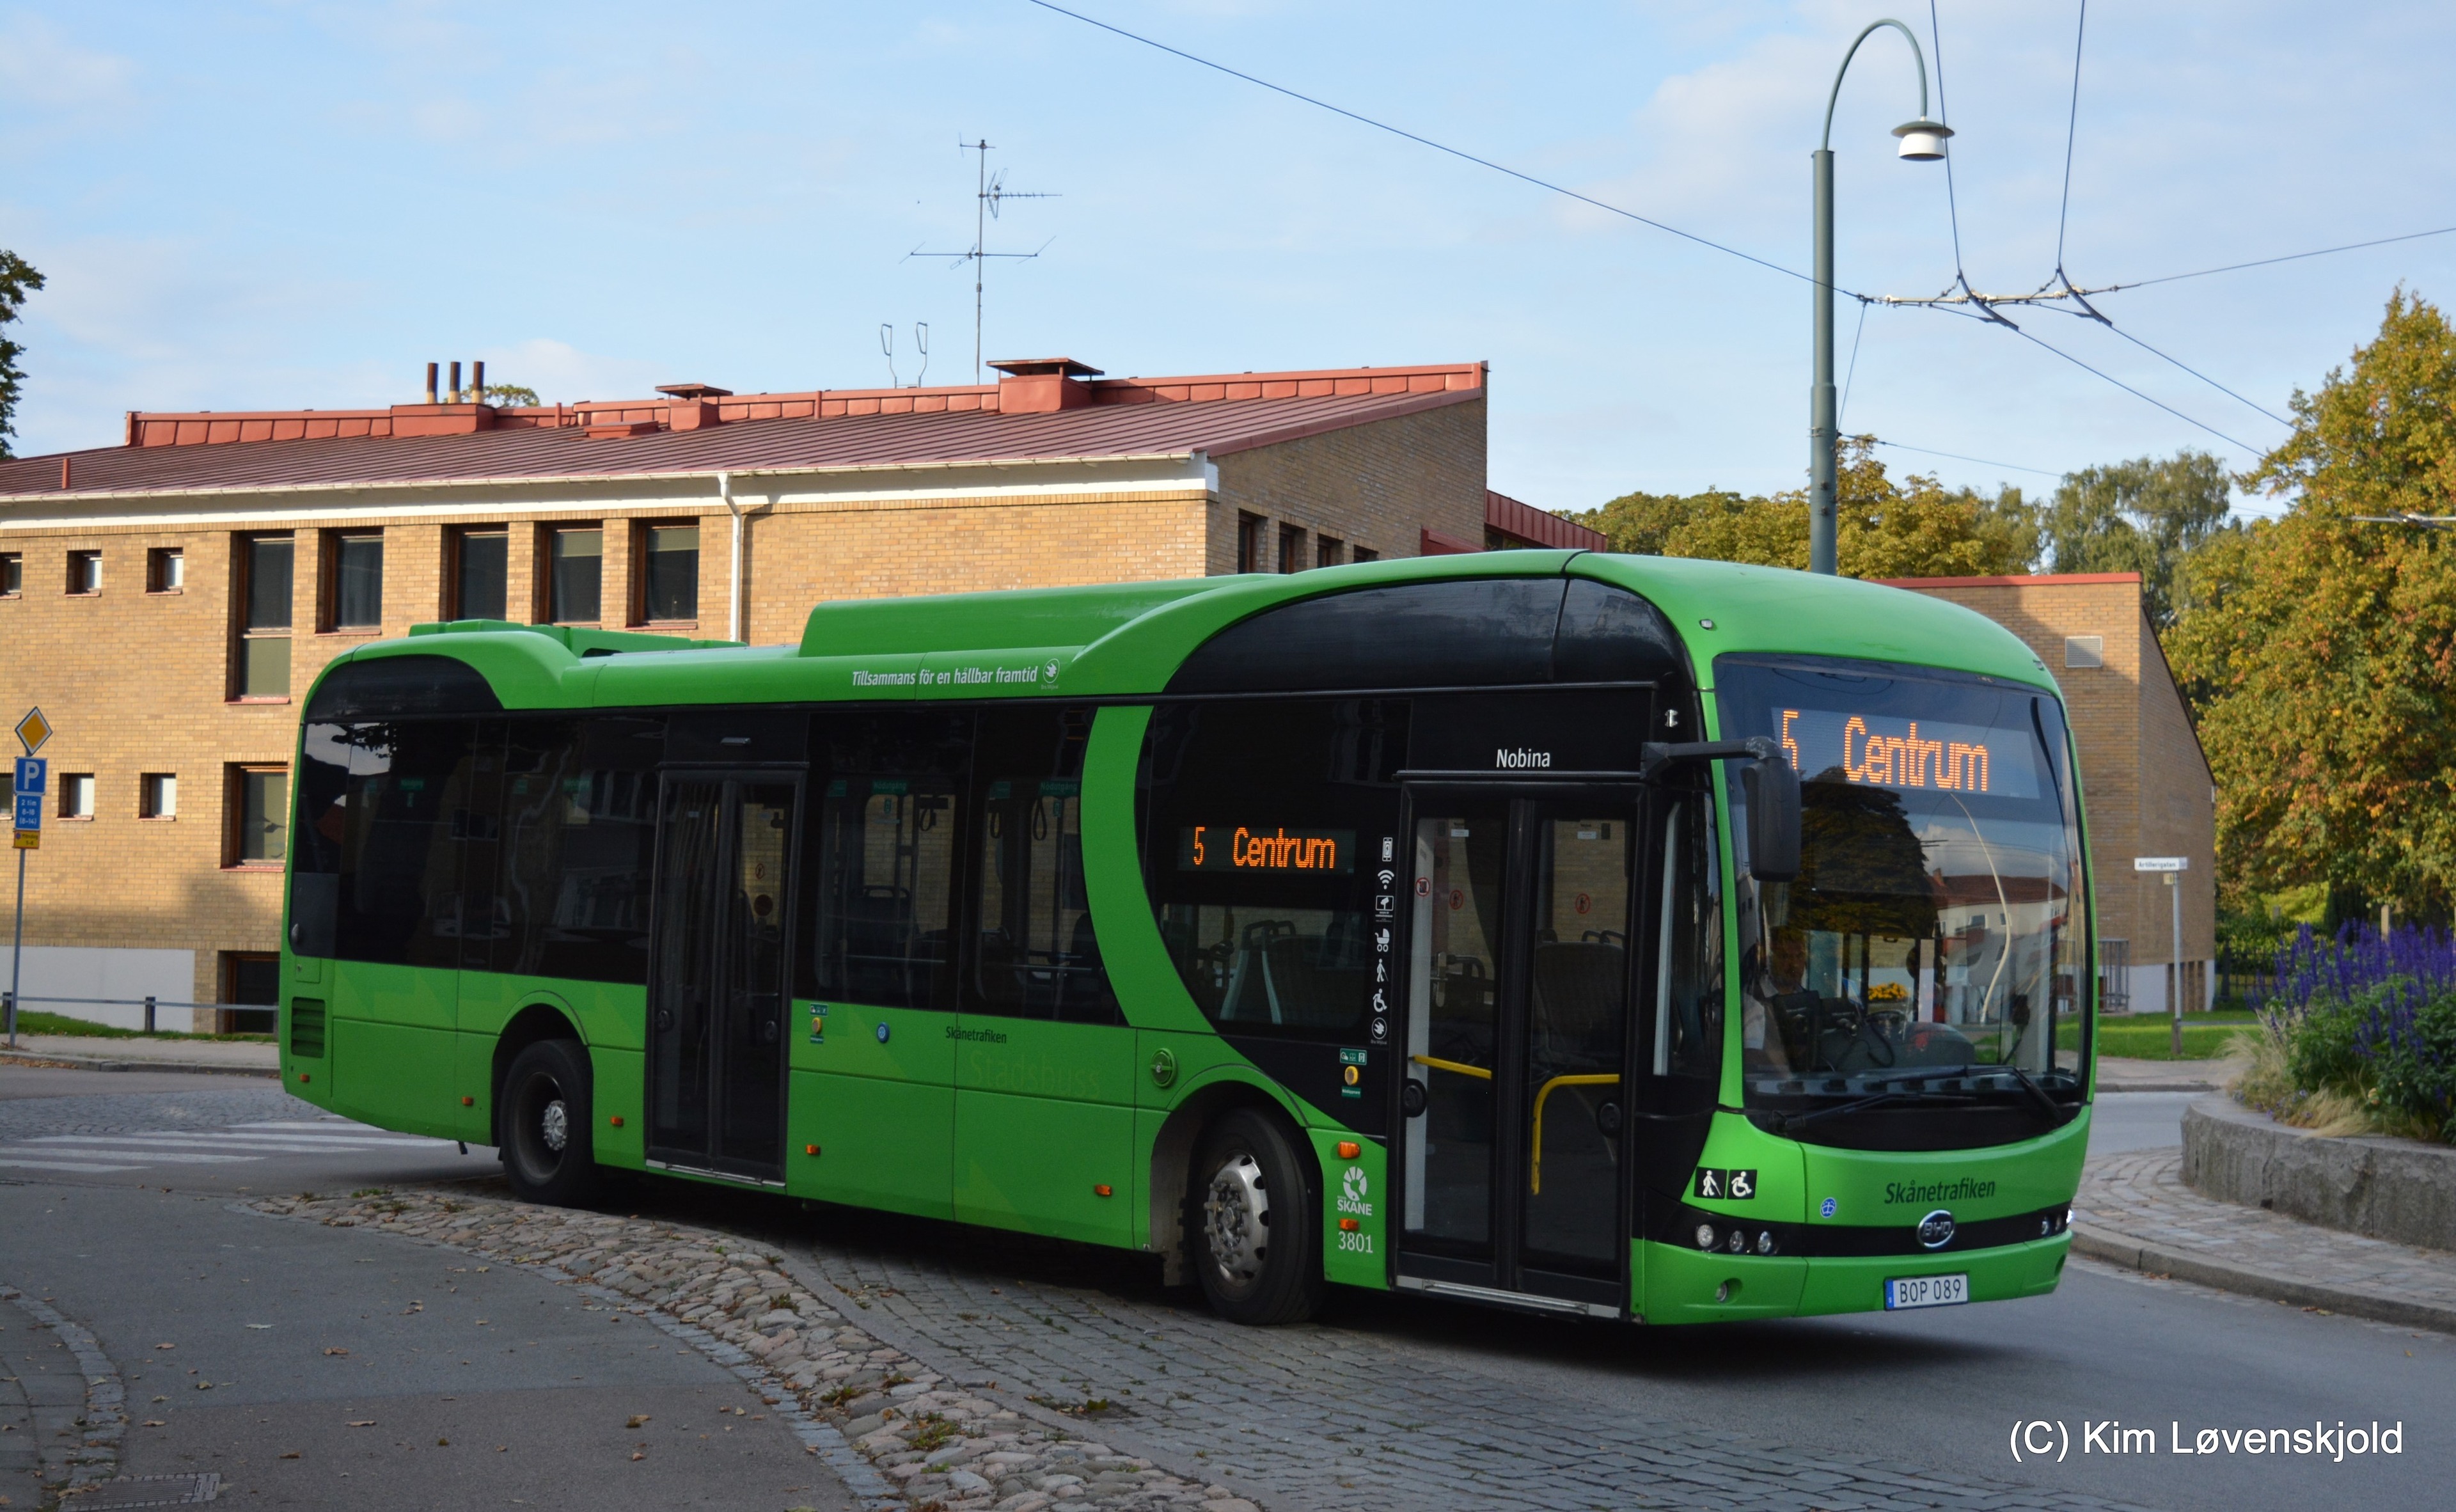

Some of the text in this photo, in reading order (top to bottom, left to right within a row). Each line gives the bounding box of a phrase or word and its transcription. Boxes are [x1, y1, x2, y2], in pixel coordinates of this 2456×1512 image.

[853, 666, 1038, 686] Tillsammans för en hållbar framtid
[1497, 748, 1550, 768] Nobina
[1844, 716, 1988, 791] Centrum
[24, 761, 40, 790] P
[1193, 826, 1335, 869] 5 Centrum
[945, 1026, 1007, 1044] Skånetrafiken
[1884, 1177, 1995, 1204] Skånetrafiken
[1922, 1221, 1951, 1237] BYD
[1338, 1231, 1373, 1254] 3801
[1900, 1279, 1961, 1303] BOP 089
